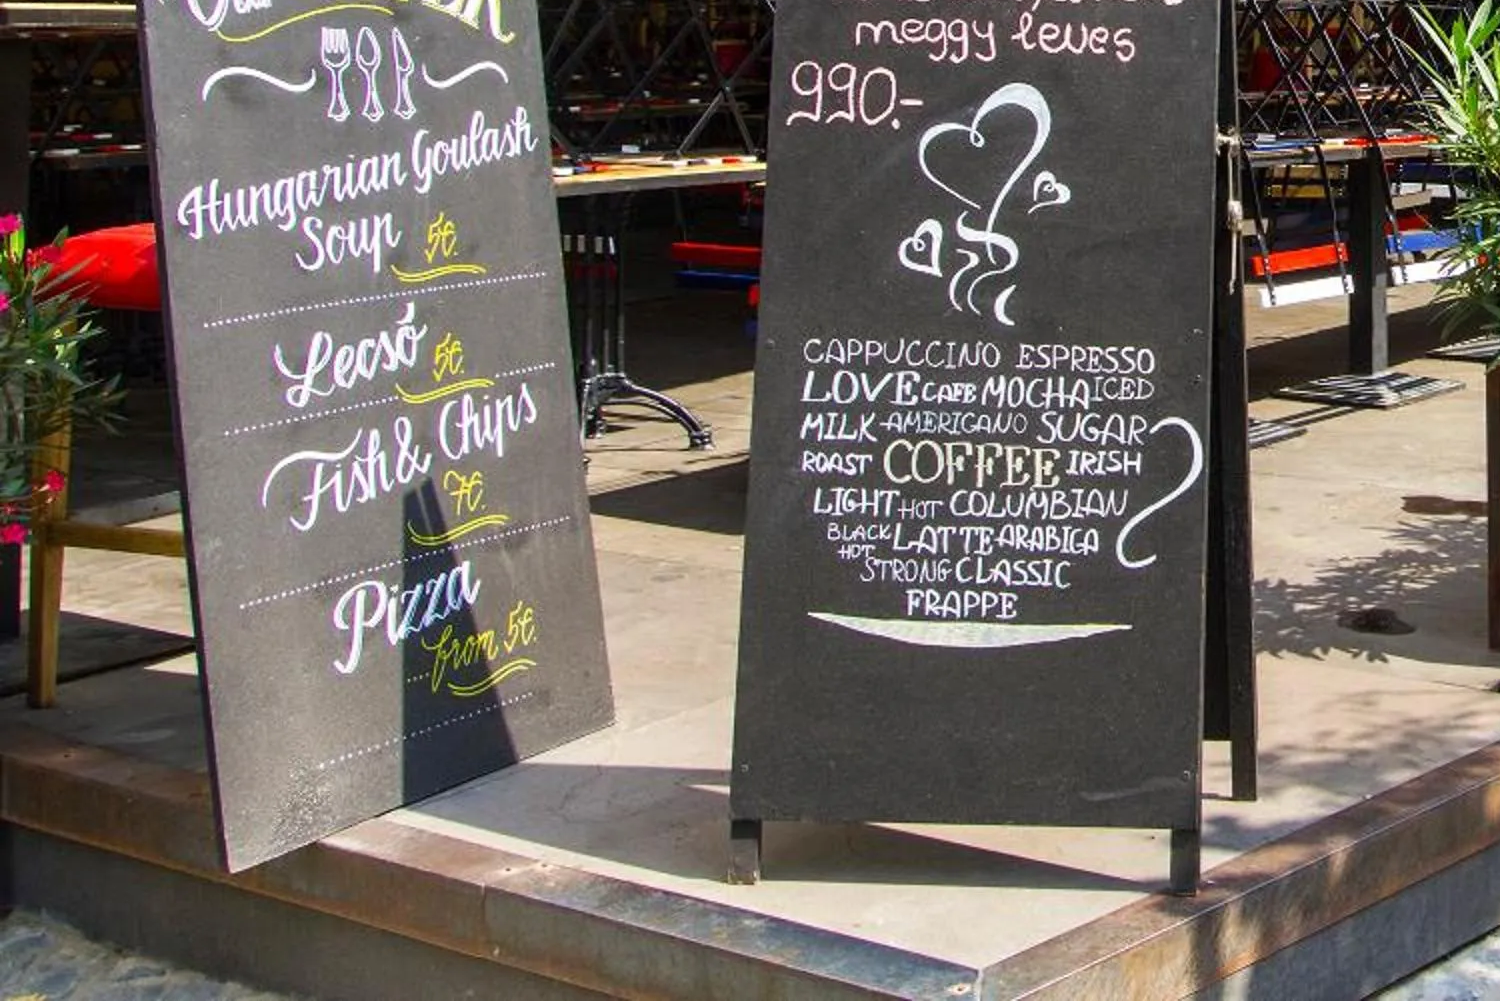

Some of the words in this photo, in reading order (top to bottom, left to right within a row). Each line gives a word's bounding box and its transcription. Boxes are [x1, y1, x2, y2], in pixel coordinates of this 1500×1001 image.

[856, 17, 995, 63] meggy
[1011, 11, 1136, 62] leves
[177, 151, 407, 240] Hungarian
[411, 106, 538, 193] Goulash
[295, 212, 400, 271] Soup
[274, 302, 427, 407] Lecsó
[803, 338, 1001, 368] CAPPUCCINO
[1015, 343, 1155, 375] ESPRESSO
[800, 370, 921, 406] LOVE
[921, 382, 976, 404] CAFE
[981, 375, 1090, 410] MOCHA
[1091, 376, 1154, 403] ICED
[800, 412, 877, 442] MILK
[880, 411, 1029, 436] AMERICANO
[1036, 411, 1148, 446] SUGAR
[262, 427, 393, 531] Fish
[394, 419, 432, 485] &
[439, 382, 538, 458] Chips
[802, 450, 873, 475] ROAST
[883, 438, 1061, 489] COFFEE
[1066, 450, 1142, 476] IRISH
[813, 487, 899, 517] LIGHT
[898, 498, 942, 521] HOT
[949, 488, 1129, 521] COLUMBIAN
[827, 523, 892, 542] BLACK
[893, 523, 995, 555] LATTE
[994, 524, 1100, 554] ARABICA
[838, 543, 876, 560] HOT
[860, 557, 952, 582] STRONG
[955, 556, 1072, 589] CLASSIC
[333, 560, 481, 675] Pizza
[906, 589, 1019, 619] FRAPPE
[421, 624, 499, 694] from
